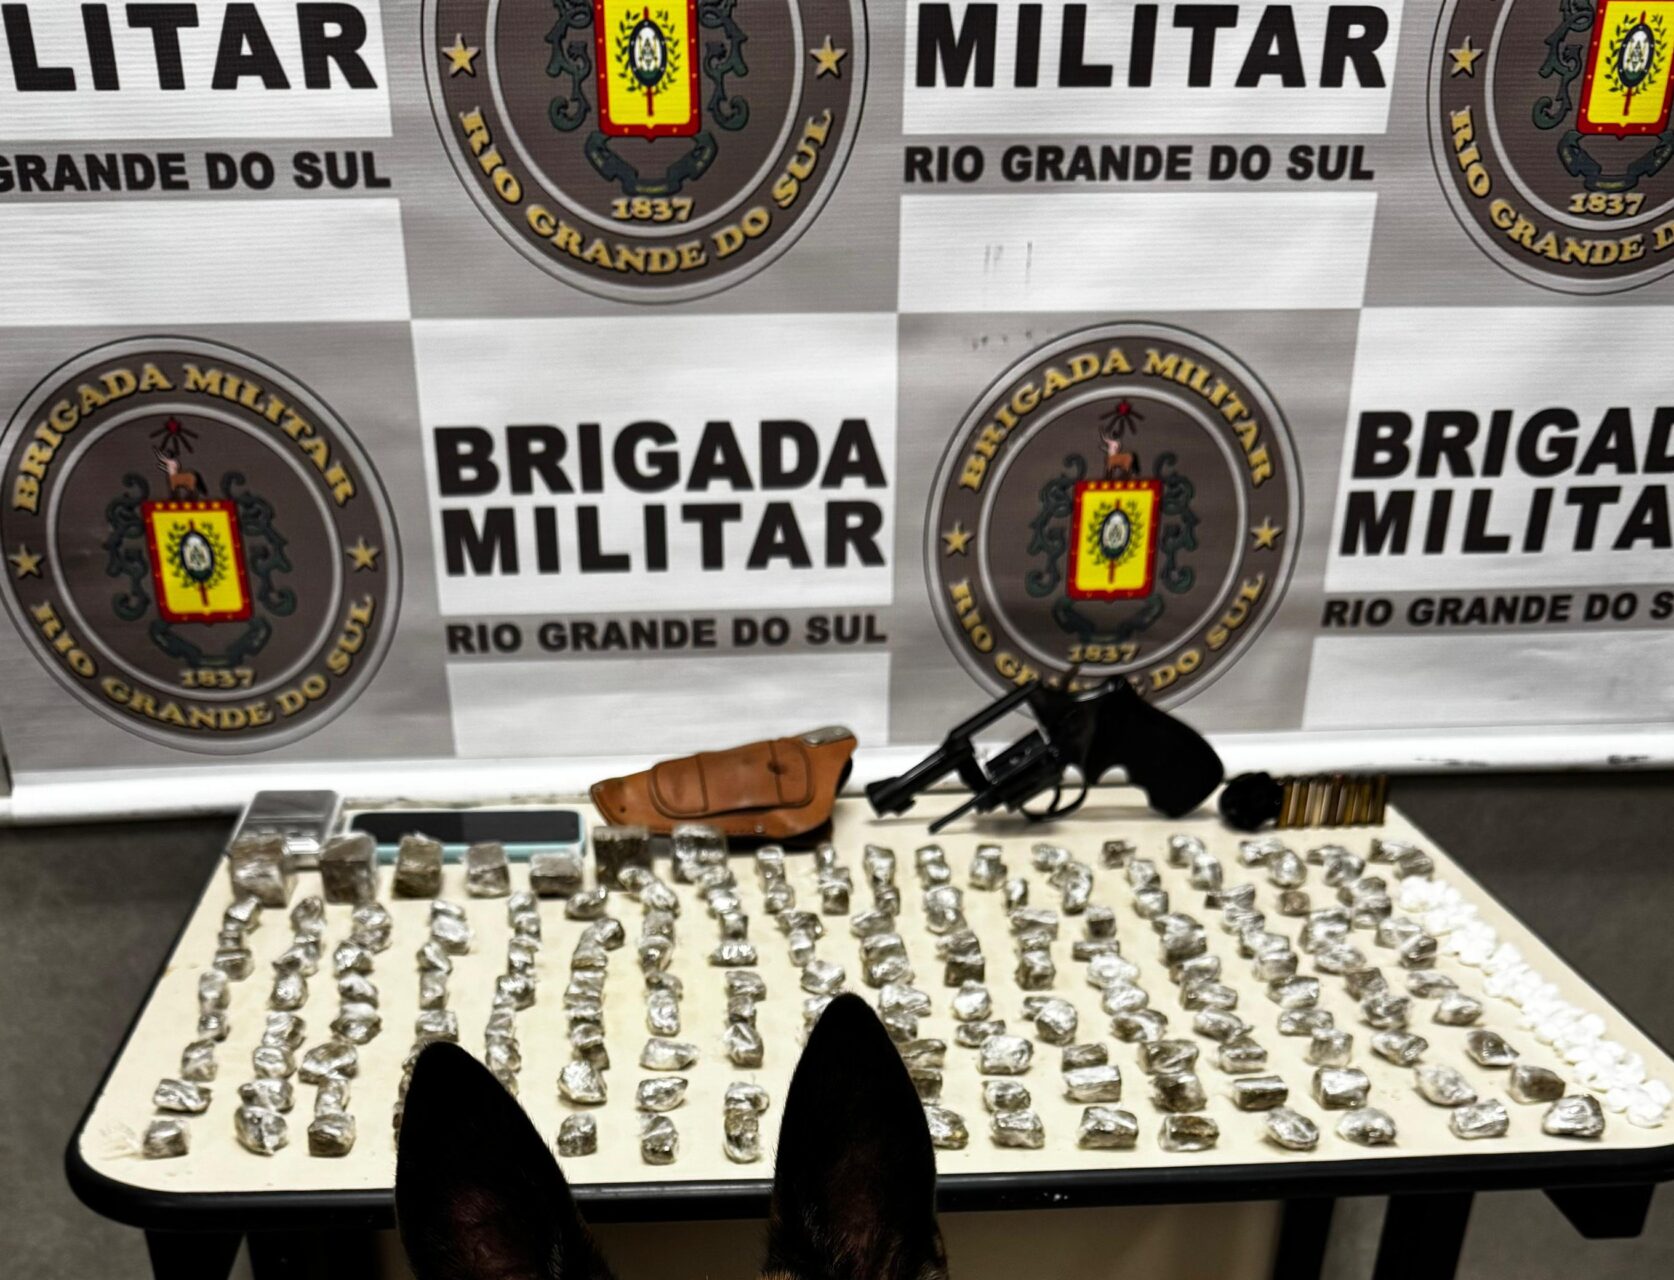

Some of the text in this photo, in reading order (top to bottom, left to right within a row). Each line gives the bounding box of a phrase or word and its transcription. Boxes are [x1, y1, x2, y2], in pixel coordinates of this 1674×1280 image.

[2, 3, 378, 91] LITAR
[916, 3, 1390, 88] MILITAR
[206, 154, 275, 190] DO
[293, 151, 392, 190] SUL
[458, 105, 835, 274] RIO GRANDE DO SUL
[904, 144, 1375, 183] RIO GRANDE DO SUL
[1449, 104, 1492, 197] RIO
[1489, 198, 1646, 265] GRANDE
[611, 196, 695, 222] 1837
[1568, 192, 1646, 217] 1837
[13, 362, 358, 514] BRIGADA MILITAR
[433, 418, 888, 497] BRIGADA
[959, 347, 1275, 492] BRIGADA MILITAR
[441, 500, 886, 576] MILITAR
[1339, 484, 1673, 556] MILITA
[446, 614, 887, 653] RIO GRANDE DO SUL
[949, 578, 994, 655] RIO
[1150, 649, 1201, 690] DO
[1205, 573, 1266, 650] SUL
[1321, 599, 1394, 628] RIO
[1407, 595, 1573, 627] GRANDE
[1584, 593, 1638, 622] DO
[30, 594, 376, 731] RIO GRANDE DO SUL
[181, 667, 255, 689] 1837
[1067, 642, 1139, 664] 1837
